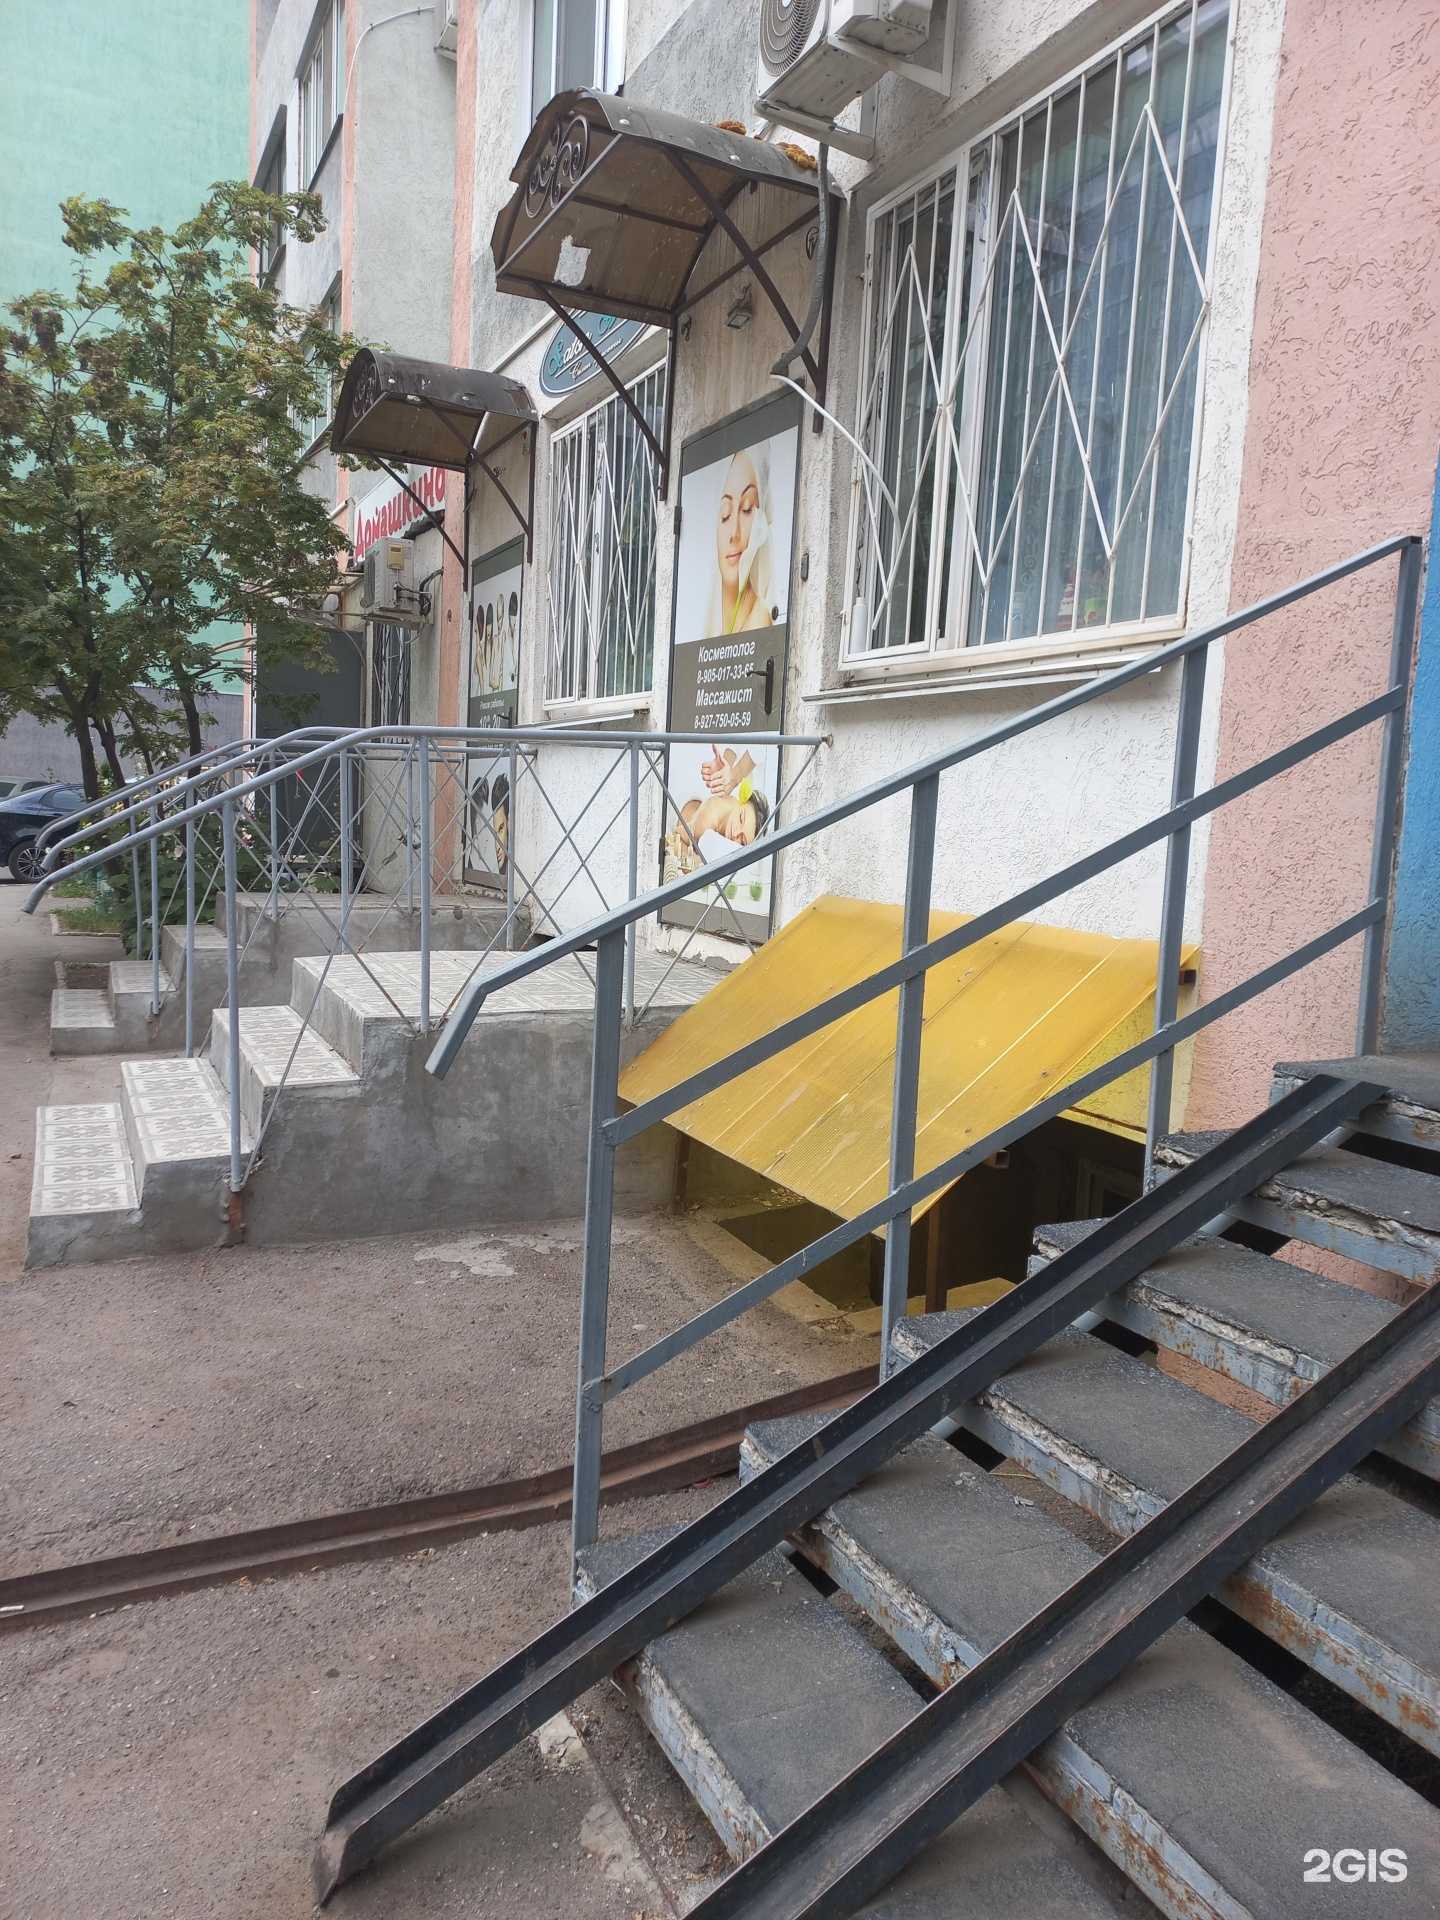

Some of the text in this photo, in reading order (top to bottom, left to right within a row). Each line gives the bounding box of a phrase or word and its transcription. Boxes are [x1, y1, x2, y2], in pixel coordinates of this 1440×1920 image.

[698, 642, 755, 662] Косметолог
[695, 688, 753, 707] Массажист
[694, 712, 752, 729] 8-927-750-05-59
